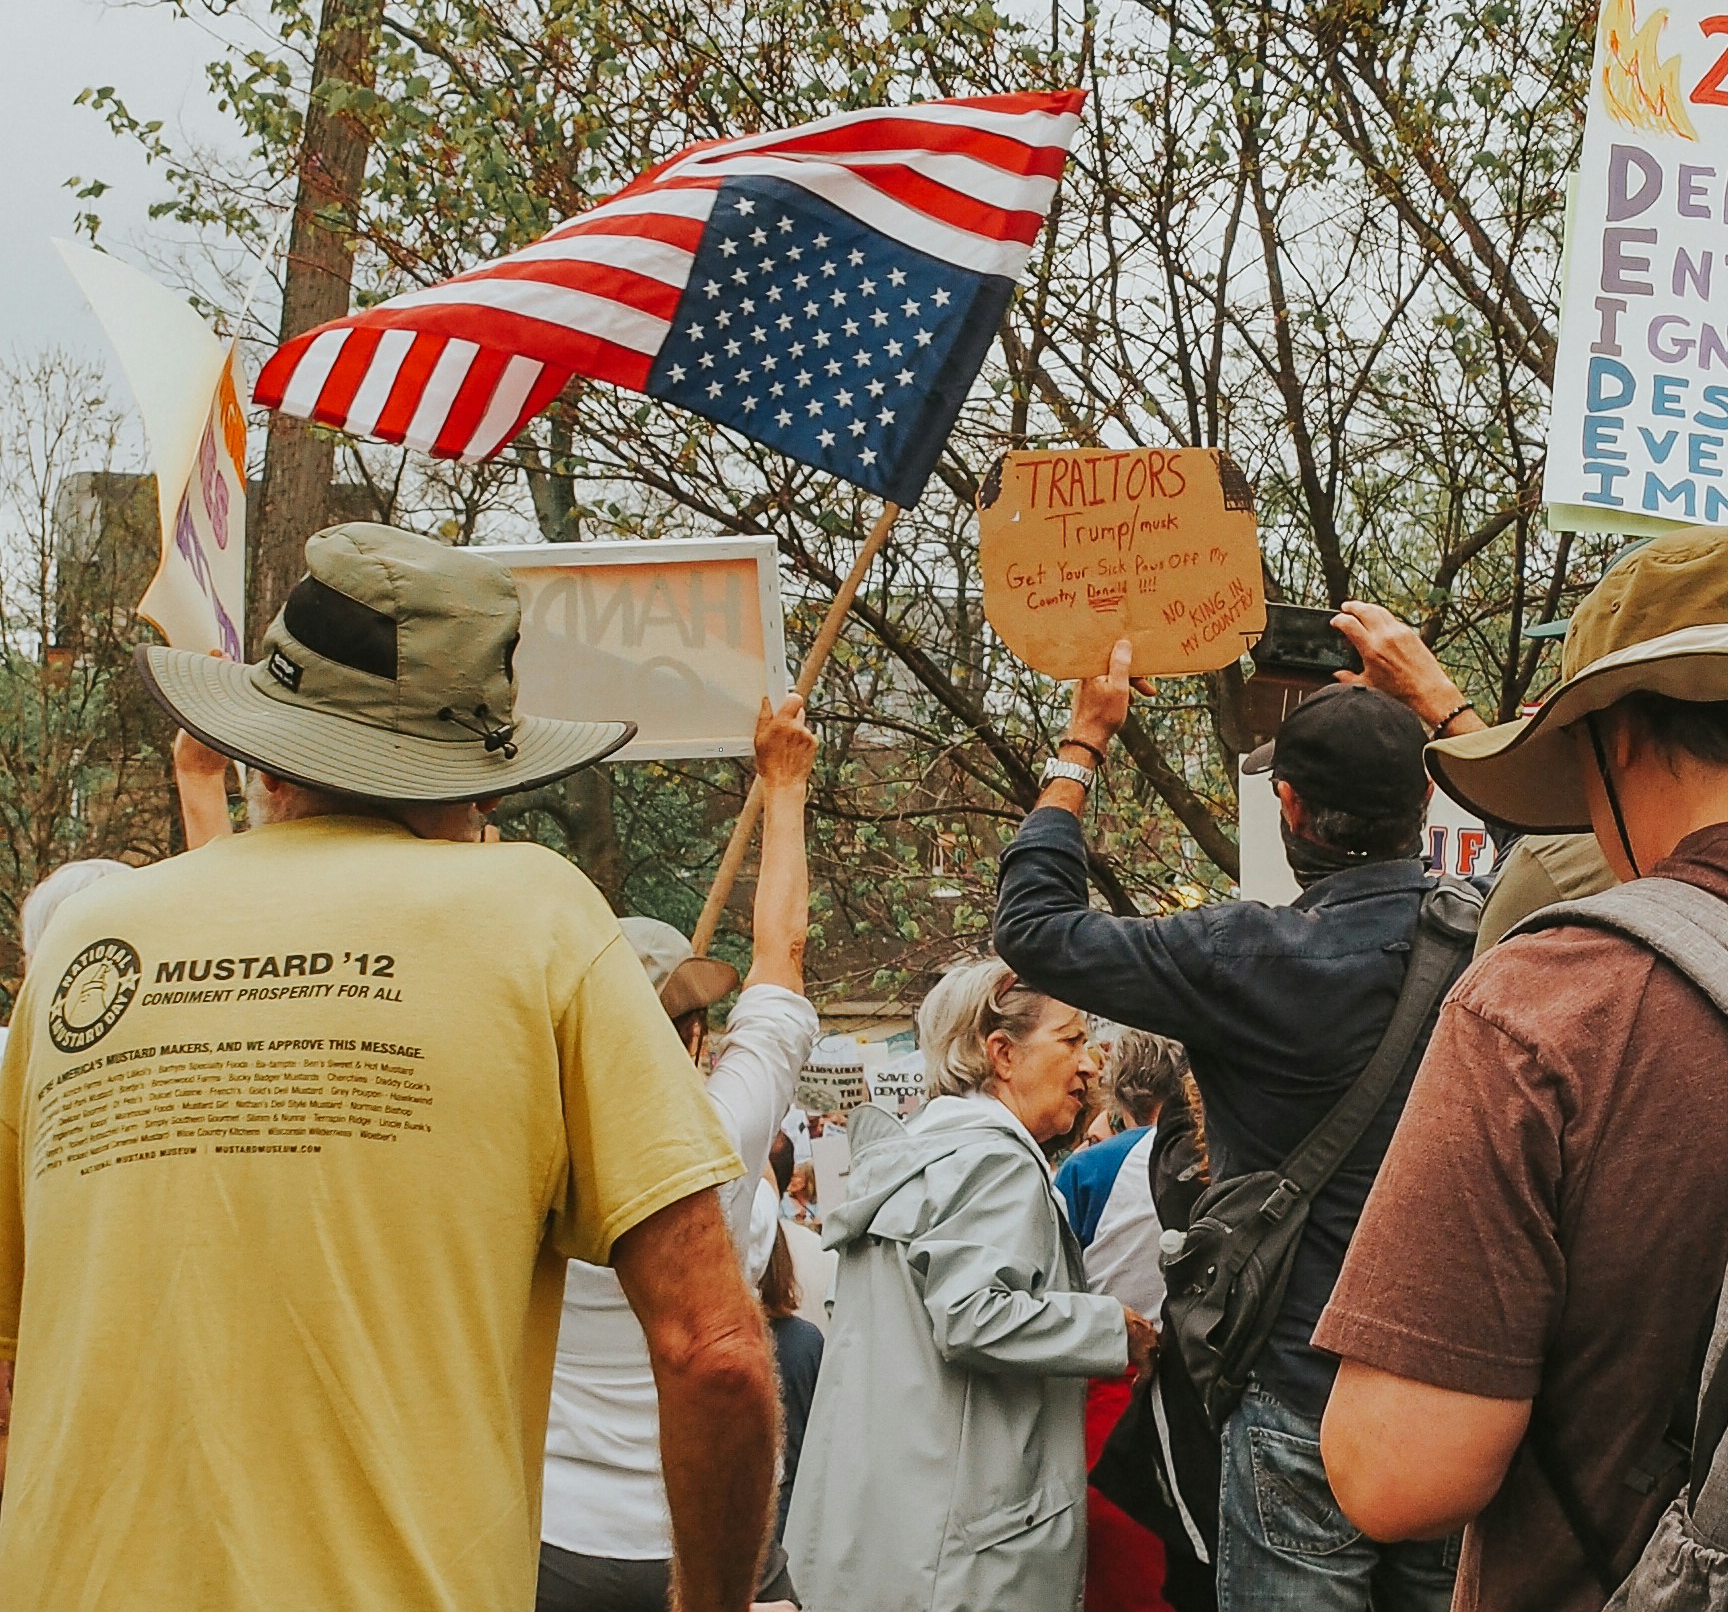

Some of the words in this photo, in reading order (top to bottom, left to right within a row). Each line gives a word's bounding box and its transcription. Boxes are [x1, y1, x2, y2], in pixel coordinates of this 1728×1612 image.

[1016, 451, 1186, 509] TRAITORS
[1006, 563, 1046, 589] Get
[1057, 561, 1089, 581] Your
[1098, 558, 1127, 576] Sick
[1026, 591, 1077, 611] Country
[1087, 580, 1127, 598] Donald
[1162, 600, 1185, 625] NO
[1189, 592, 1226, 627] KING
[1229, 577, 1246, 599] IN
[1181, 638, 1202, 657] MY
[1202, 588, 1255, 642] COUNTRY
[61, 944, 132, 988] NATIONAL
[155, 952, 335, 984] MUSTARD
[343, 951, 396, 979] '12
[141, 989, 235, 1006] CONDIMENT
[237, 984, 335, 1002] PROSPERITY
[337, 985, 370, 999] FOR
[373, 988, 404, 1003] ALL
[51, 1018, 105, 1048] MUSTARD
[105, 994, 128, 1025] DAY
[106, 1047, 156, 1066] MUSTARD
[160, 1042, 212, 1056] MAKERS,
[216, 1041, 242, 1052] AND
[246, 1040, 264, 1051] WE
[268, 1039, 324, 1051] APPROVE
[329, 1039, 356, 1051] THIS
[839, 1088, 863, 1098] THE
[877, 1072, 909, 1083] SAVE
